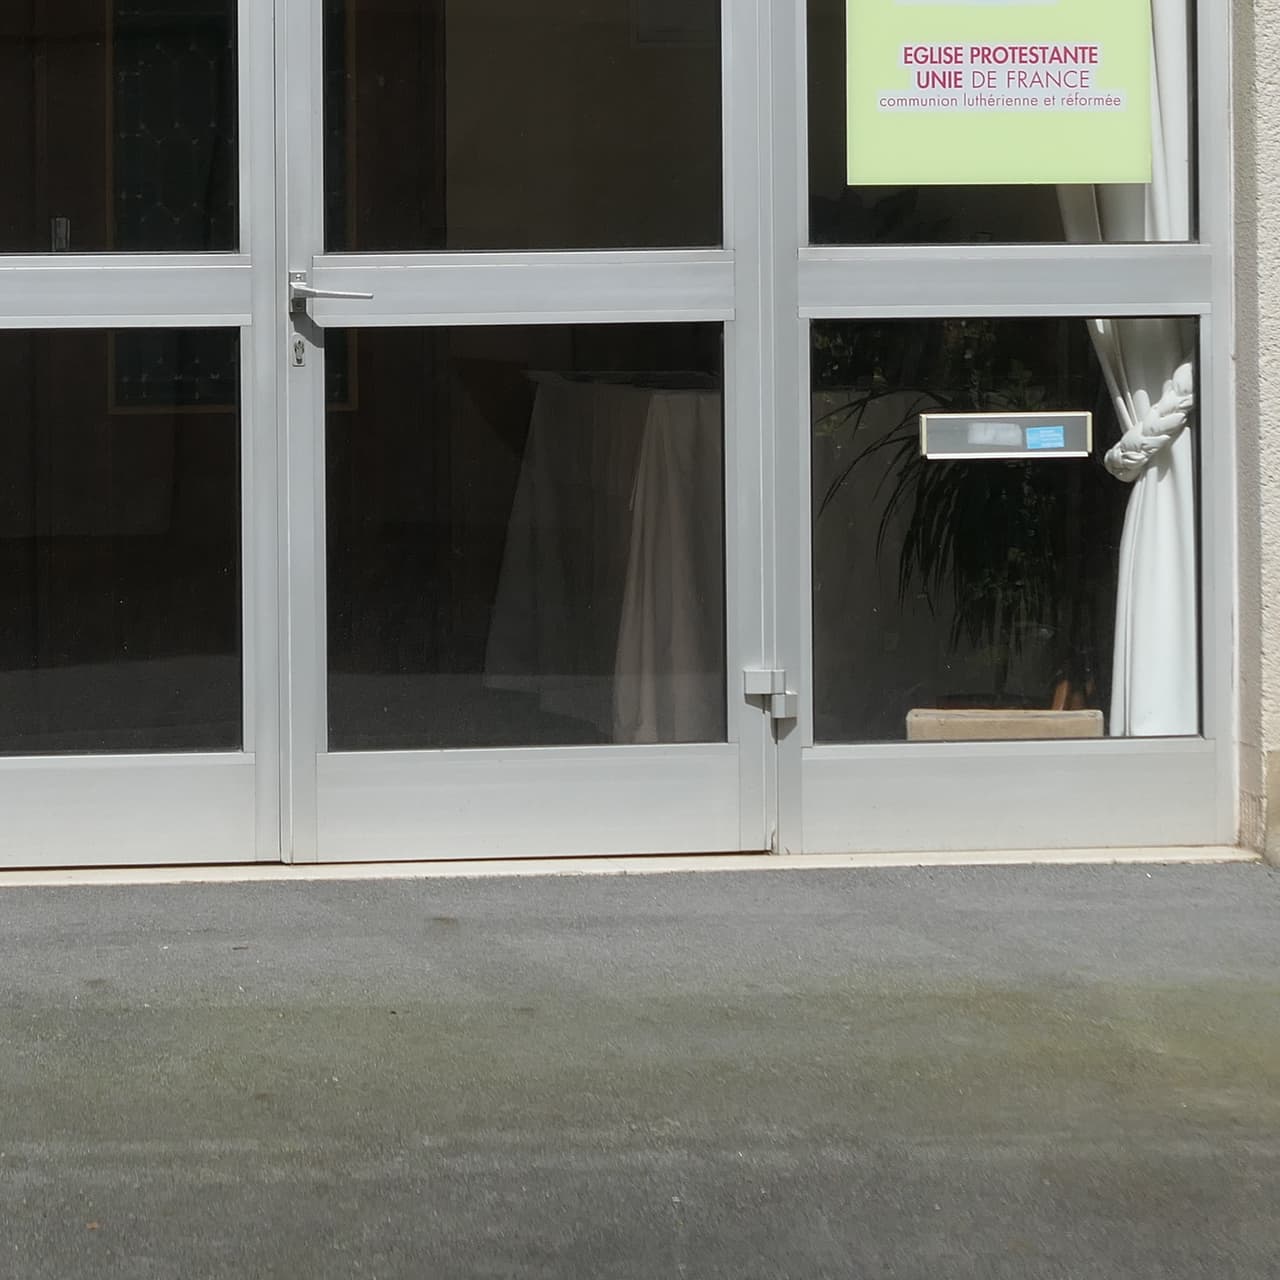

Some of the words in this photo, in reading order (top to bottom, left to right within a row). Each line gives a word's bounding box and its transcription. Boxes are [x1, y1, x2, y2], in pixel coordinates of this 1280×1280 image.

[903, 46, 963, 64] EGLISE
[970, 46, 1098, 64] PROTESTANTE
[916, 71, 963, 89] UNIE
[972, 71, 997, 89] DE
[1007, 71, 1090, 89] FRANCE
[879, 94, 958, 107] communion
[963, 93, 1038, 107] luthérienne
[1044, 95, 1056, 107] et
[1061, 92, 1121, 107] réformée
